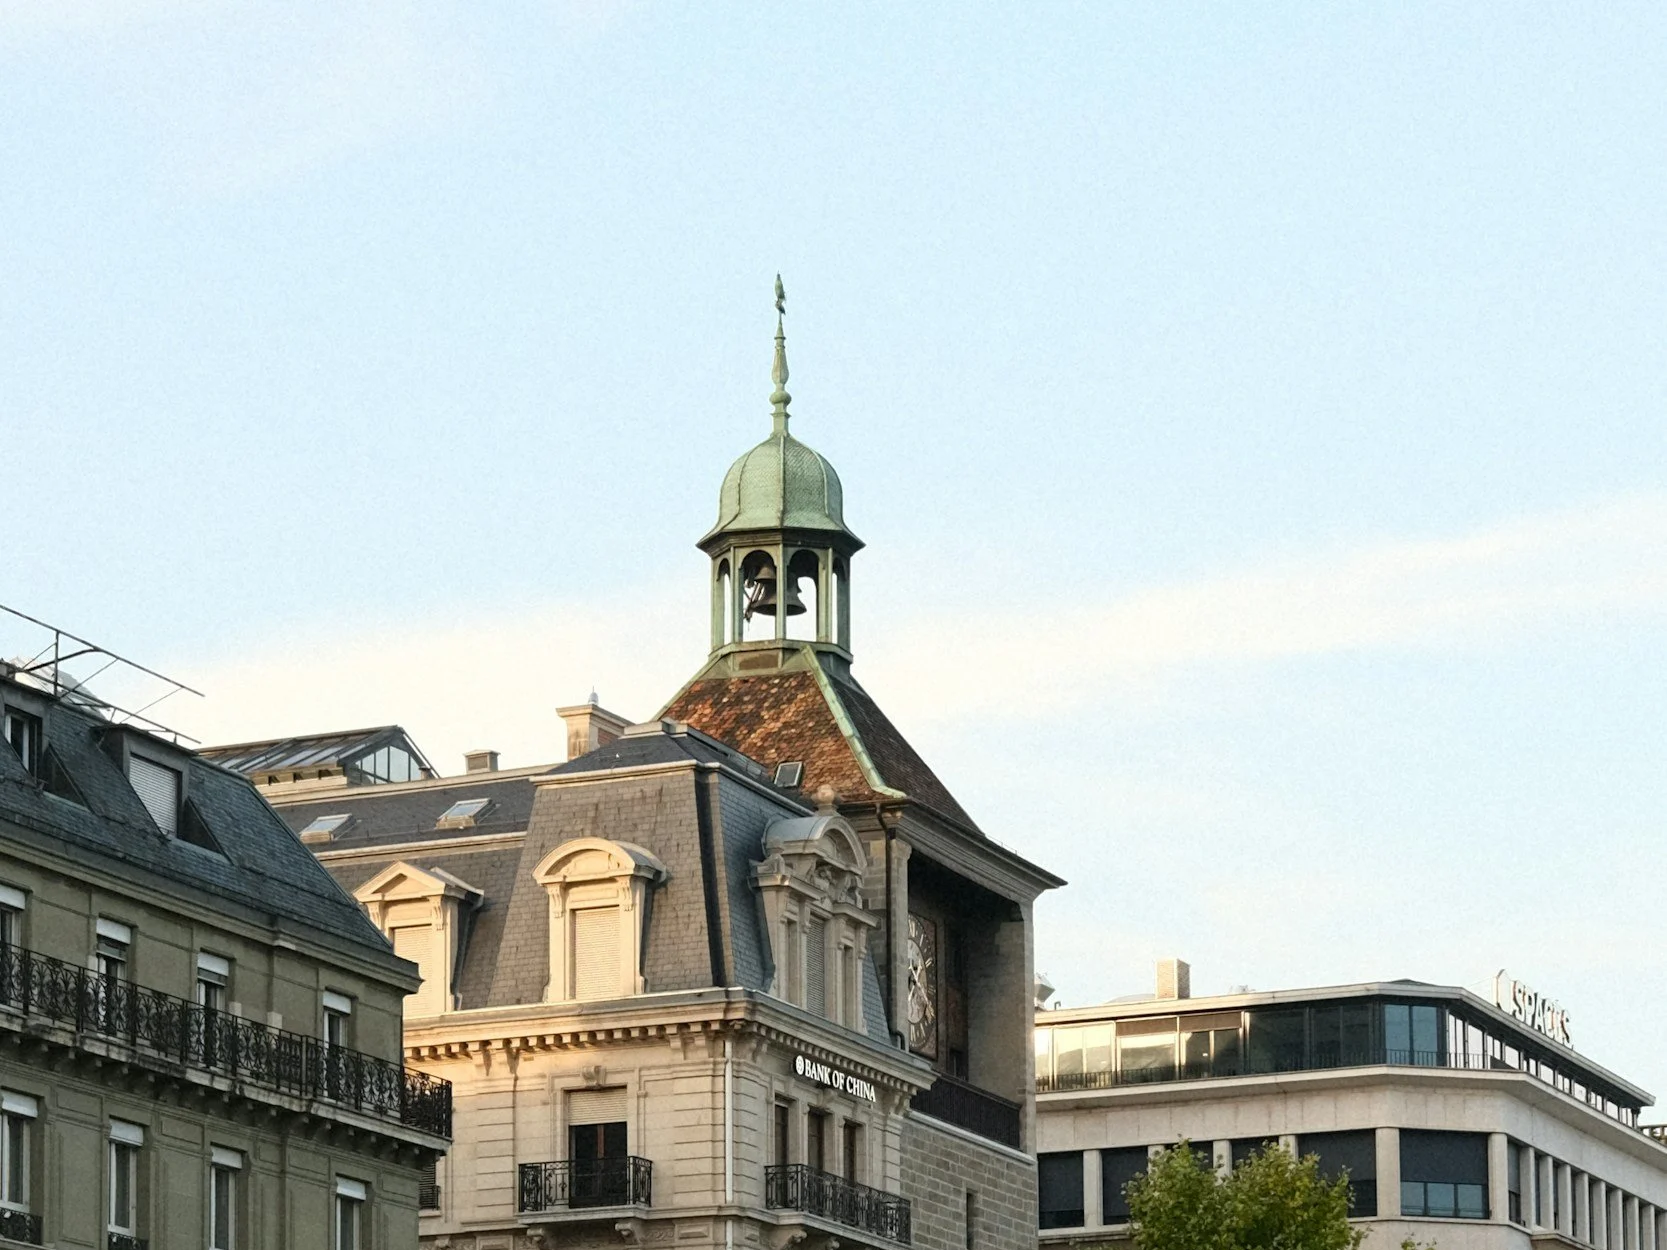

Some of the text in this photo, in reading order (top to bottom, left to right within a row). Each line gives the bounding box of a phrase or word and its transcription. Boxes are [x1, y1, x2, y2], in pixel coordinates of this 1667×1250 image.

[805, 1058, 876, 1102] BANK OF CHINA
